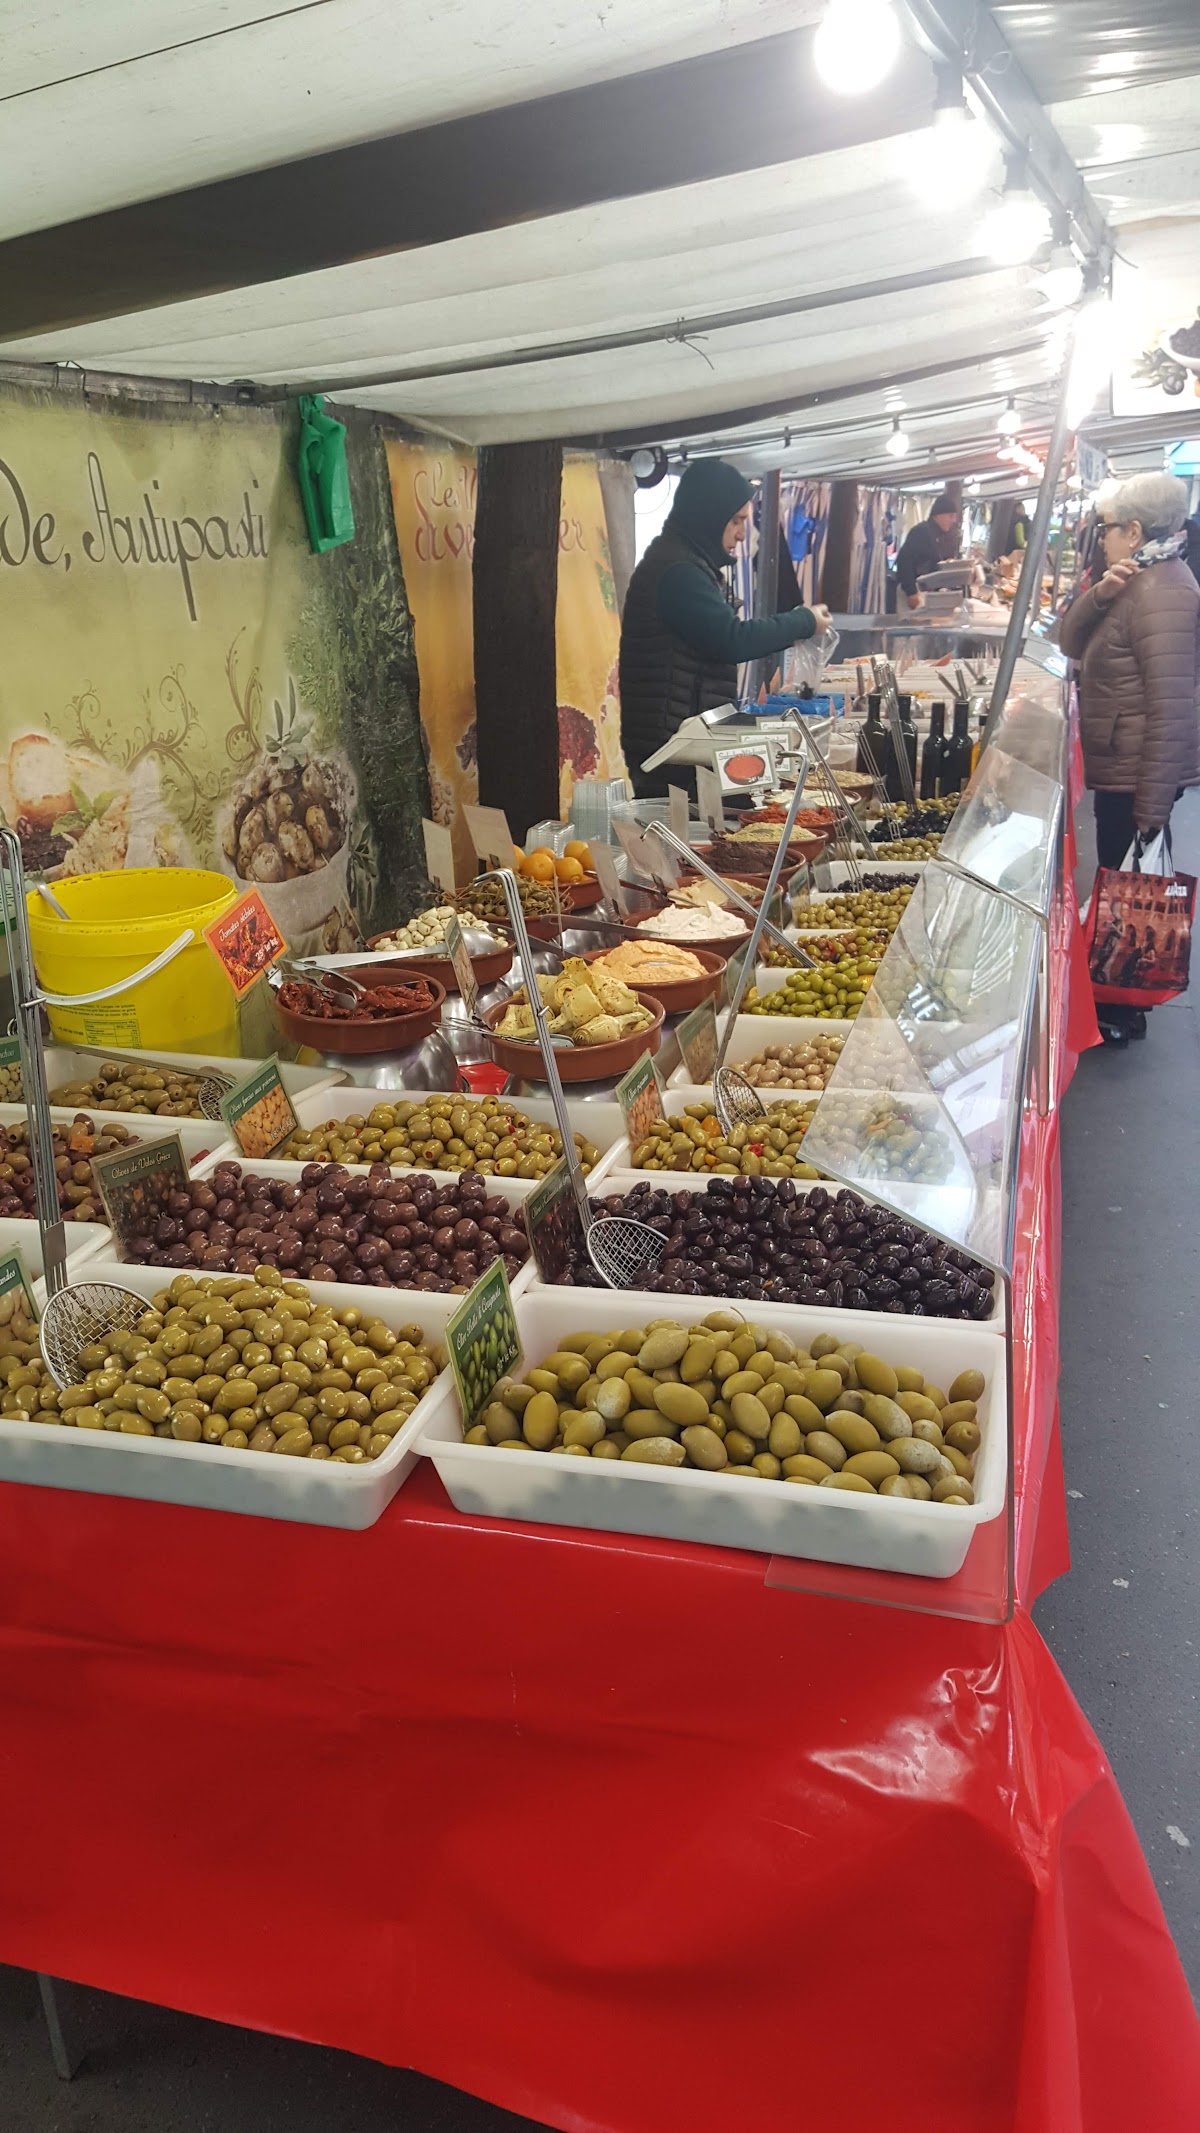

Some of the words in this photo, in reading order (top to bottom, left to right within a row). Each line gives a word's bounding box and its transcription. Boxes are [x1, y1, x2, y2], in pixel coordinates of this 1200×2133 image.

[219, 921, 239, 942] Tomates
[230, 1102, 242, 1115] Olives
[111, 1168, 130, 1179] Olives
[131, 1162, 138, 1173] de
[139, 1158, 155, 1169] Volos
[156, 1152, 171, 1165] Grèce
